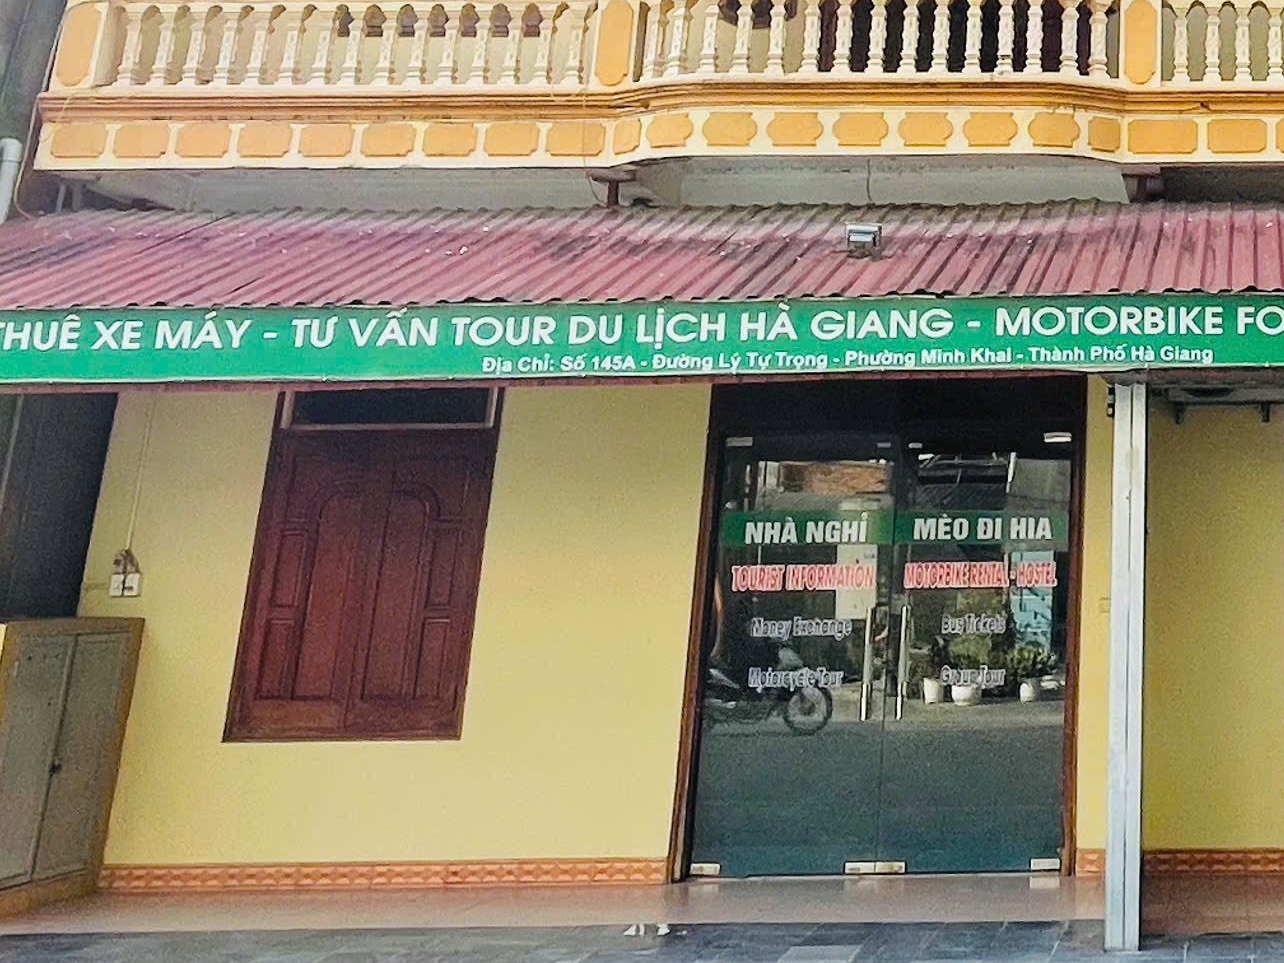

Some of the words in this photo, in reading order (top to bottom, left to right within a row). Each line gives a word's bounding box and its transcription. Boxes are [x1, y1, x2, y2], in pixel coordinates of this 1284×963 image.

[0, 314, 81, 350] HUÊ
[91, 320, 143, 349] XE
[155, 310, 252, 349] MÁY
[292, 316, 338, 348] TƯ
[349, 308, 437, 347] VẤN
[451, 315, 556, 346] TOUR
[567, 315, 623, 344] DU
[636, 308, 726, 350] LỊCH
[740, 302, 798, 341] HÀ
[810, 307, 954, 339] GIANG
[995, 305, 1224, 337] MOTORBIKE
[481, 356, 512, 375] Địa
[560, 353, 587, 371] Số
[591, 355, 636, 370] 145A
[652, 353, 713, 371] Đường
[718, 353, 741, 374] Lý
[747, 352, 772, 370] Tự
[775, 352, 828, 370] Trọng
[844, 349, 916, 367] Phường
[921, 348, 965, 364] Minh
[970, 347, 1012, 363] Khai
[1028, 346, 1085, 362] Thành
[1090, 343, 1129, 361] Phố
[1131, 345, 1155, 361] Hà
[1160, 346, 1214, 364] Giang
[745, 516, 798, 544] NHÀ
[806, 511, 868, 543] NGHỈ
[976, 517, 1002, 539] ĐI
[1009, 517, 1053, 540] HIA
[731, 565, 785, 591] TOURIST
[786, 563, 877, 591] INFORMATION
